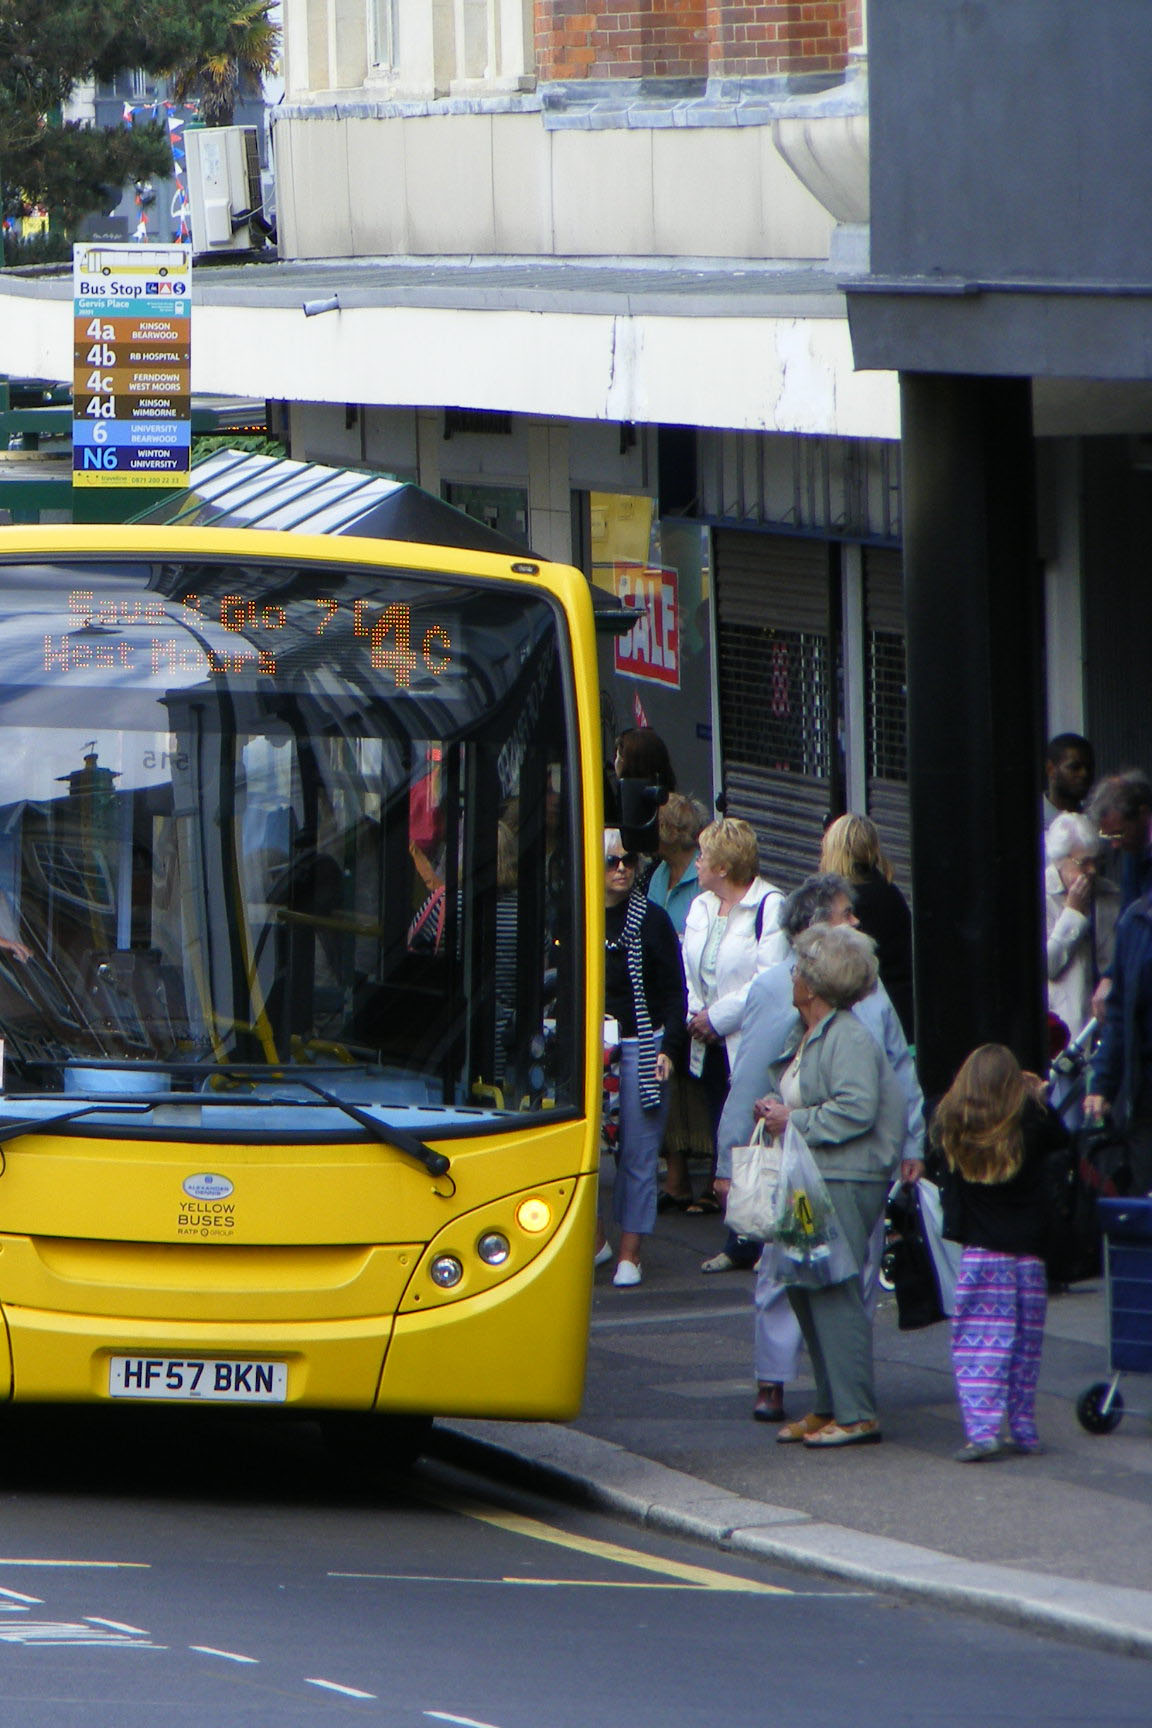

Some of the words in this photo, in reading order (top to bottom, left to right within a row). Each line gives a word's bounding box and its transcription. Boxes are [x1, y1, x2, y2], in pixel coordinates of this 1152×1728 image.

[80, 281, 106, 295] Bus
[110, 281, 142, 298] Stop
[78, 299, 105, 309] Gervis
[106, 299, 129, 309] Place
[86, 318, 116, 341] 4a
[139, 322, 171, 330] KINSON
[132, 331, 179, 339] BEARWOOD
[86, 343, 116, 367] 4b
[130, 352, 141, 361] RB
[142, 352, 180, 361] HOSPITAL
[86, 370, 114, 393] 4c
[133, 373, 180, 382] FERNDOWN
[129, 382, 149, 391] WEST
[151, 382, 181, 391] MOORS
[86, 395, 116, 419] 4d
[139, 398, 170, 407] KINSON
[132, 407, 177, 417] WIMBORNE
[92, 420, 108, 444] 6
[130, 424, 178, 433] UNIVERSITY
[131, 435, 177, 443] BEARWOOD
[83, 446, 118, 470] N6
[137, 449, 171, 458] WINTON
[130, 460, 177, 469] UNIVERSITY
[68, 590, 166, 627] Save
[618, 574, 677, 672] SALE
[44, 634, 136, 673] West
[150, 638, 277, 675] Moors
[179, 1202, 236, 1214] YELLOW
[177, 1214, 235, 1227] BUSES
[209, 1229, 234, 1237] GROUP
[124, 1359, 205, 1392] HF57
[213, 1362, 274, 1393] BKN
